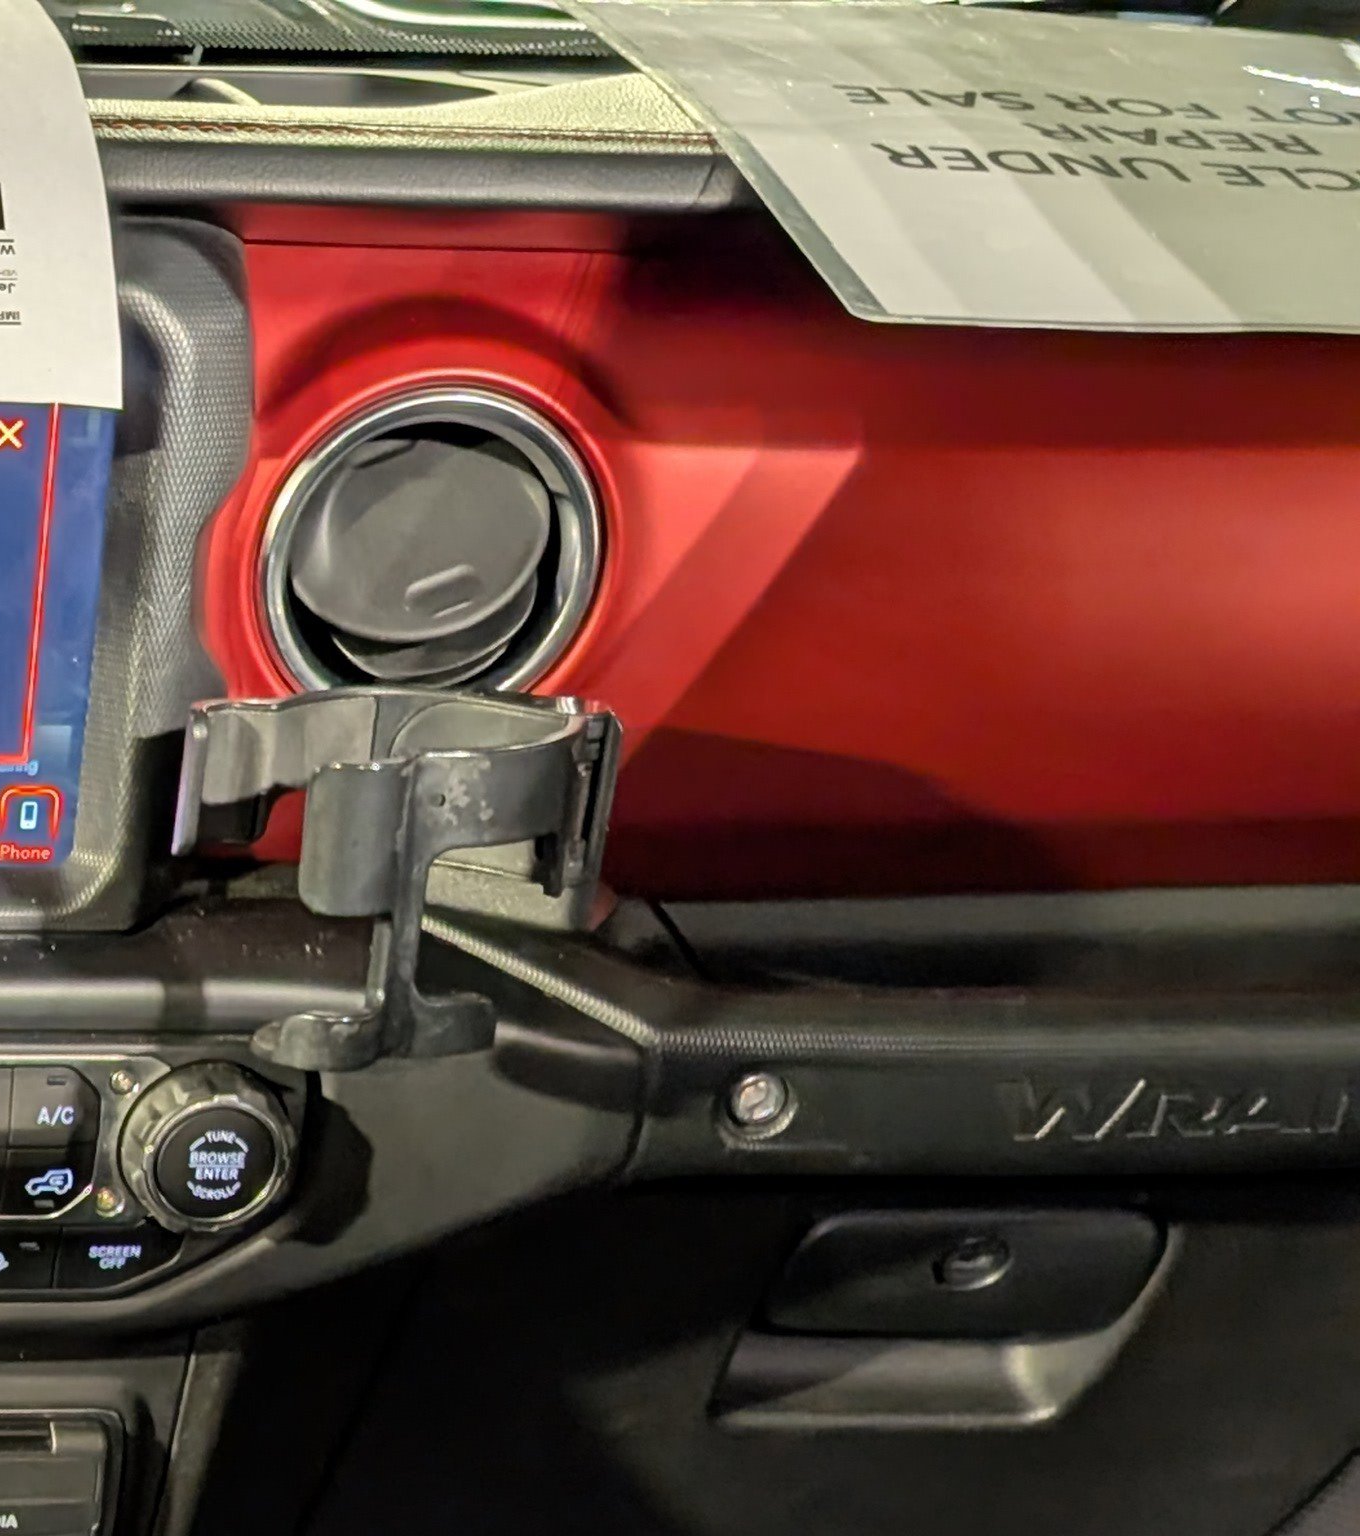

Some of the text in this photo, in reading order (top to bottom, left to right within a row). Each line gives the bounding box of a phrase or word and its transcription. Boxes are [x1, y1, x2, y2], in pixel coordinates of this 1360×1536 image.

[832, 84, 1221, 121] FOR SALE
[1021, 123, 1322, 157] REPAIR
[871, 142, 1191, 184] UNDER
[0, 844, 51, 861] Phone
[37, 1106, 75, 1126] A/C
[204, 1129, 237, 1143] TUNE
[190, 1152, 247, 1165] BROWSE
[194, 1167, 239, 1180] ENTER
[88, 1245, 142, 1258] SCREEN
[99, 1257, 126, 1270] OFF
